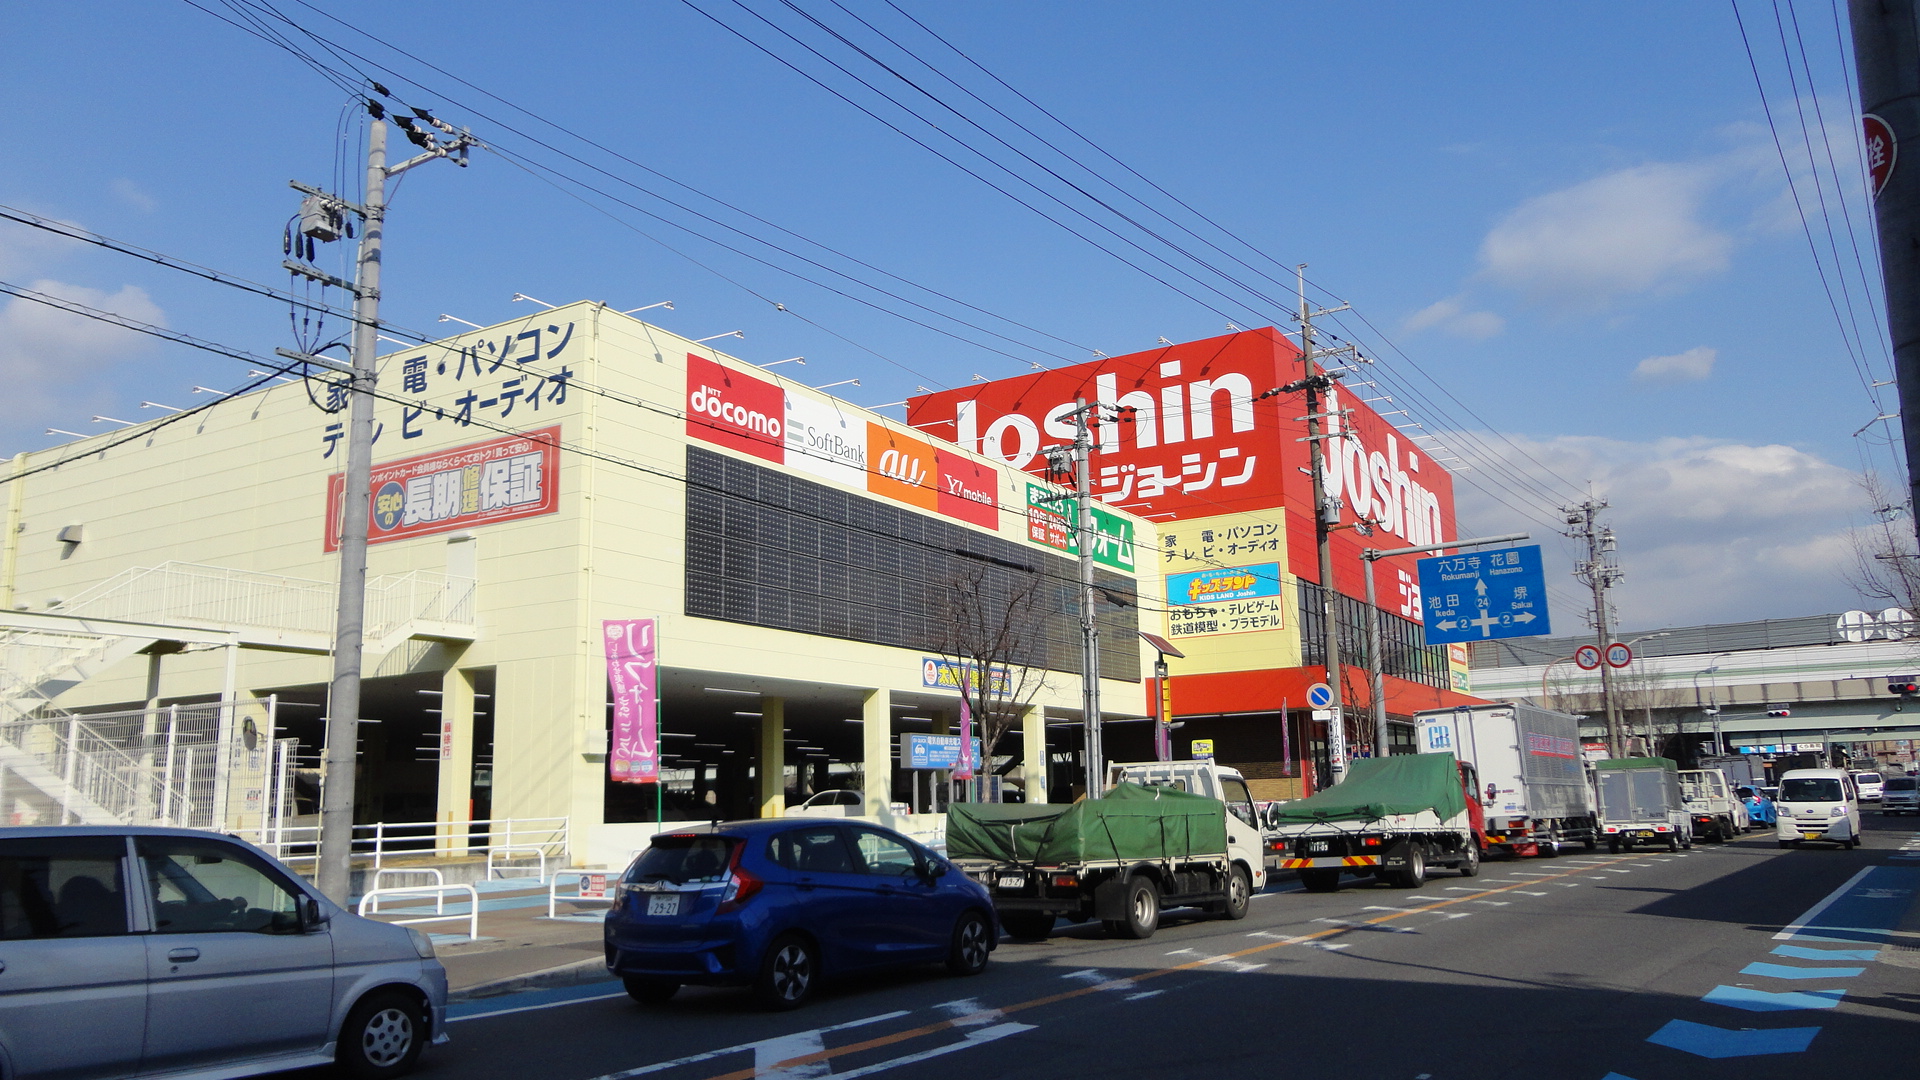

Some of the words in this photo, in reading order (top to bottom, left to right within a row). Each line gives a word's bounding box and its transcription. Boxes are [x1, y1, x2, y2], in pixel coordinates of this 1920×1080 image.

[708, 387, 722, 398] NTT
[690, 384, 781, 438] docomo
[957, 360, 1255, 471] Joshin
[807, 426, 865, 466] SoftBank
[878, 449, 927, 488] au
[1101, 446, 1257, 504] ジョーシン
[1320, 386, 1443, 556] Joshin
[403, 468, 462, 527] 長期
[481, 450, 543, 512] 保証
[383, 512, 394, 525] の
[1031, 526, 1045, 541] 保証
[1049, 532, 1067, 547] サポート
[1438, 556, 1482, 573] 六万寺
[1490, 551, 1520, 567] 花園
[1441, 570, 1480, 581] Rokumanji
[1489, 566, 1523, 576] Hanazono
[1188, 574, 1257, 602] キッズランド
[1236, 590, 1256, 598] Joshin
[1513, 586, 1528, 600] 堺
[1428, 593, 1460, 610] 池田
[1477, 598, 1489, 608] 24
[1511, 601, 1533, 610] Sakai
[1435, 609, 1455, 617] Ikeda
[1503, 615, 1511, 625] 2
[1460, 619, 1468, 629] 2
[1611, 649, 1627, 661] 40
